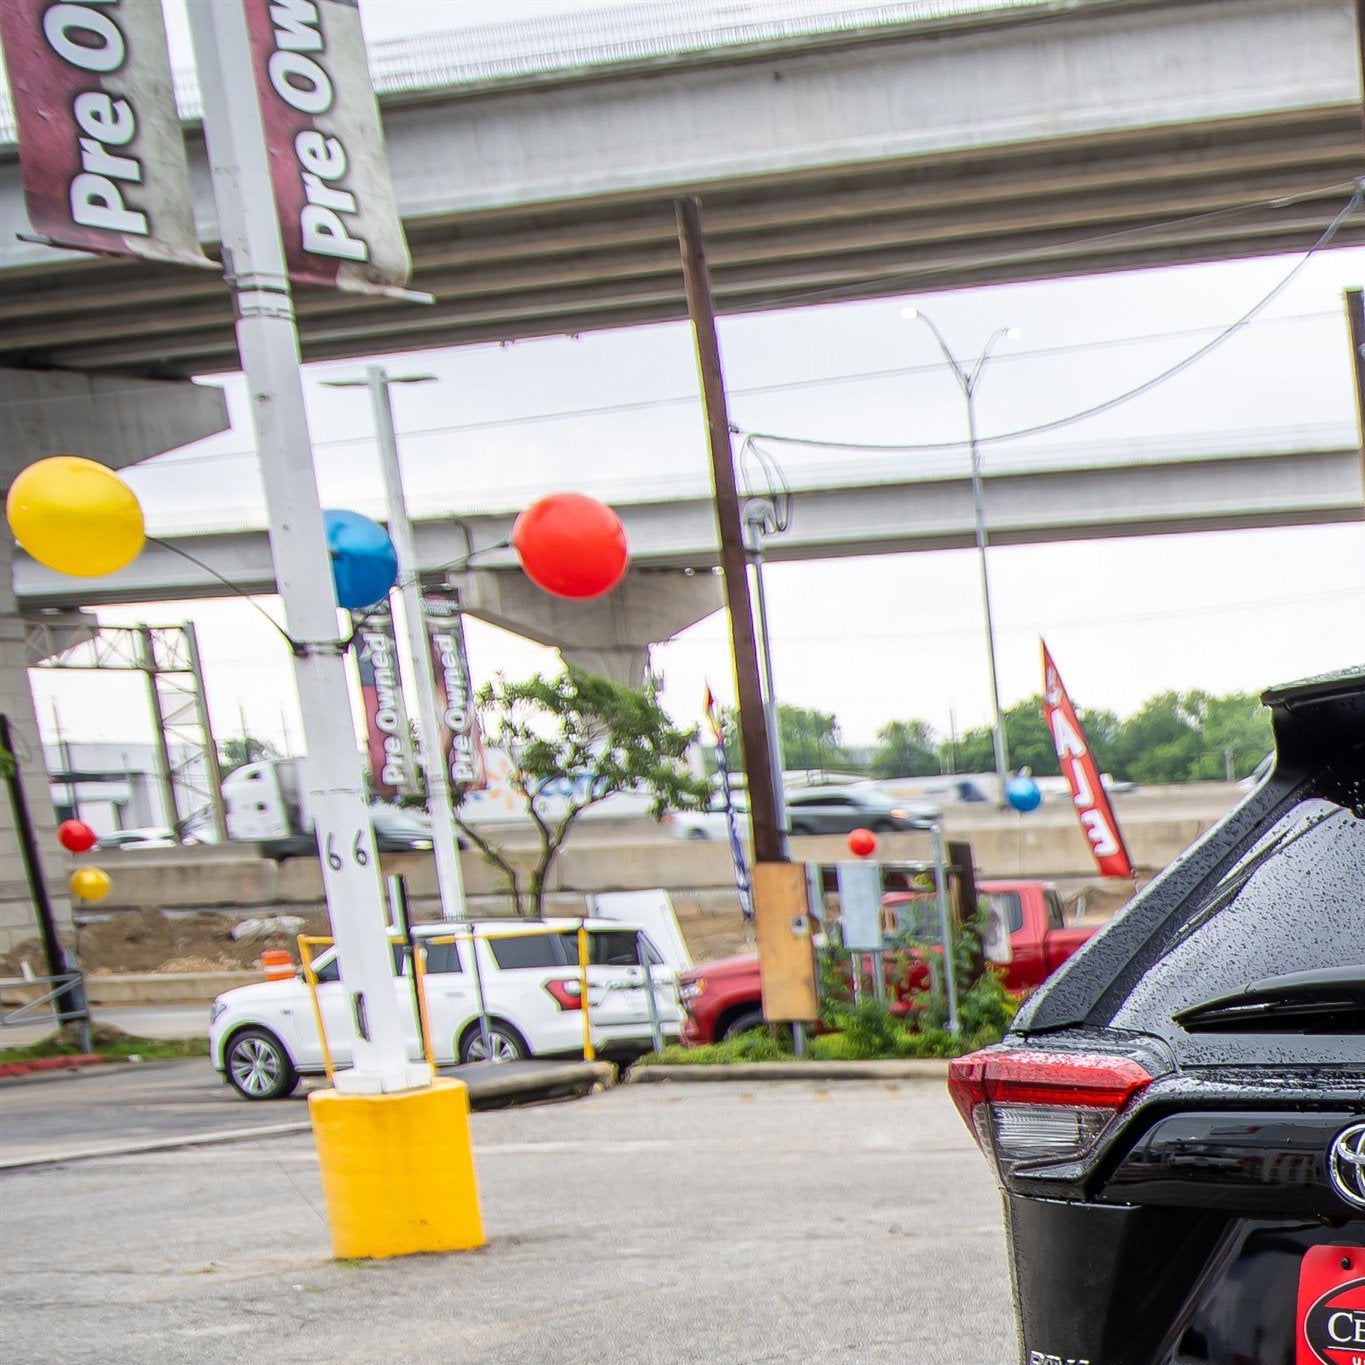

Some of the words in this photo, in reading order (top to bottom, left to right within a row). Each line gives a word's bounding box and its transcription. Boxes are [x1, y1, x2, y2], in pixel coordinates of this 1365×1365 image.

[43, 0, 125, 72] O
[70, 91, 148, 235] Pre
[294, 130, 369, 262] Pre
[360, 632, 399, 732] Owned
[432, 633, 468, 732] Owned
[382, 735, 406, 785] Pre
[451, 734, 476, 784] Pre
